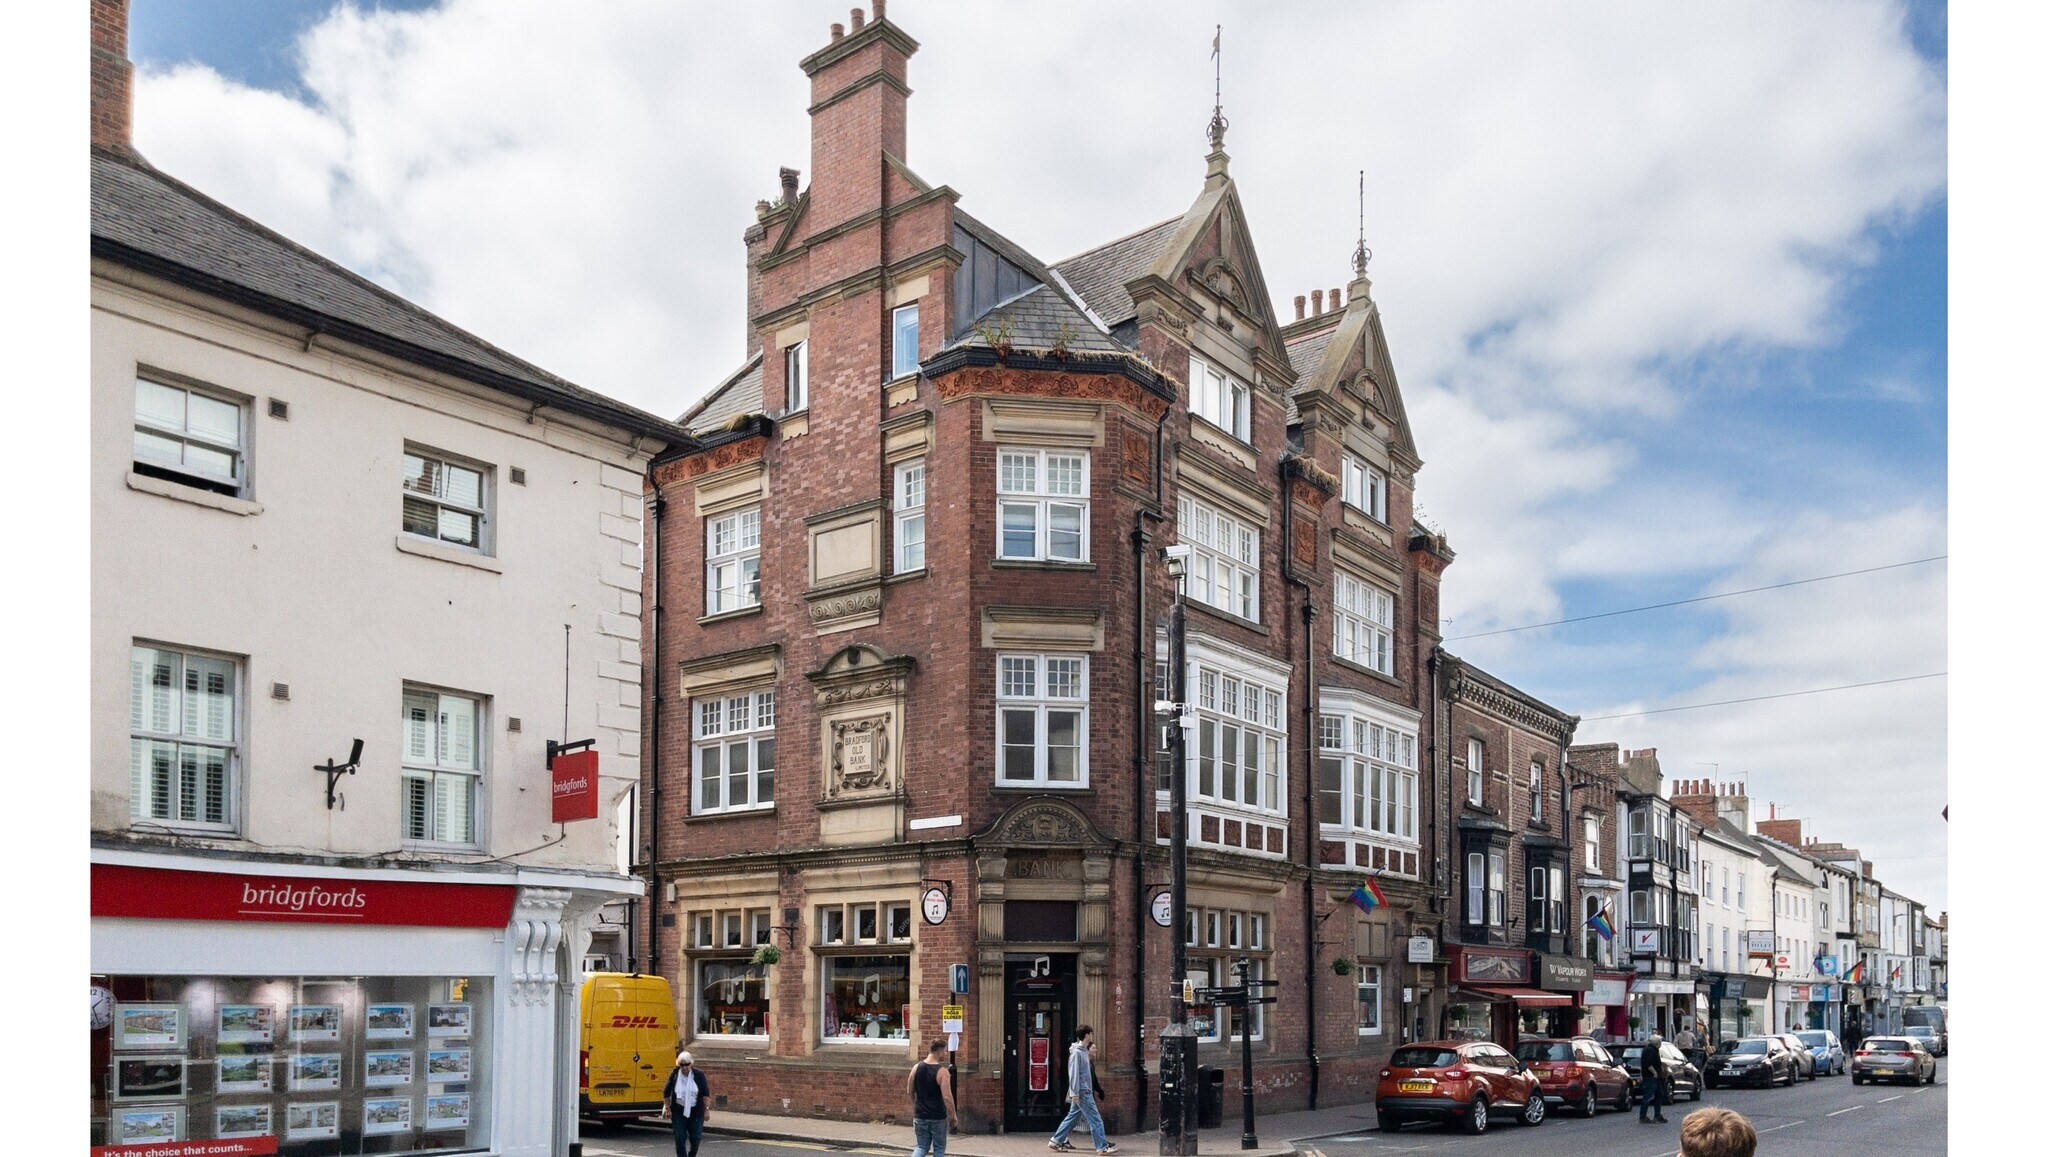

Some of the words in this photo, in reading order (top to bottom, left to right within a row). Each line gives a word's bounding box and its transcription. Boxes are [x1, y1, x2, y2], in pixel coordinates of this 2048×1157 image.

[845, 734, 871, 746] BRADFORD
[851, 745, 863, 755] OLD
[850, 755, 866, 765] BANK
[553, 776, 588, 794] bridgfords
[1018, 859, 1070, 878] BANK
[242, 882, 367, 911] bridgfords
[611, 1015, 660, 1029] DHL
[145, 1148, 181, 1157] choice
[184, 1146, 206, 1155] that
[208, 1144, 253, 1154] counts...
